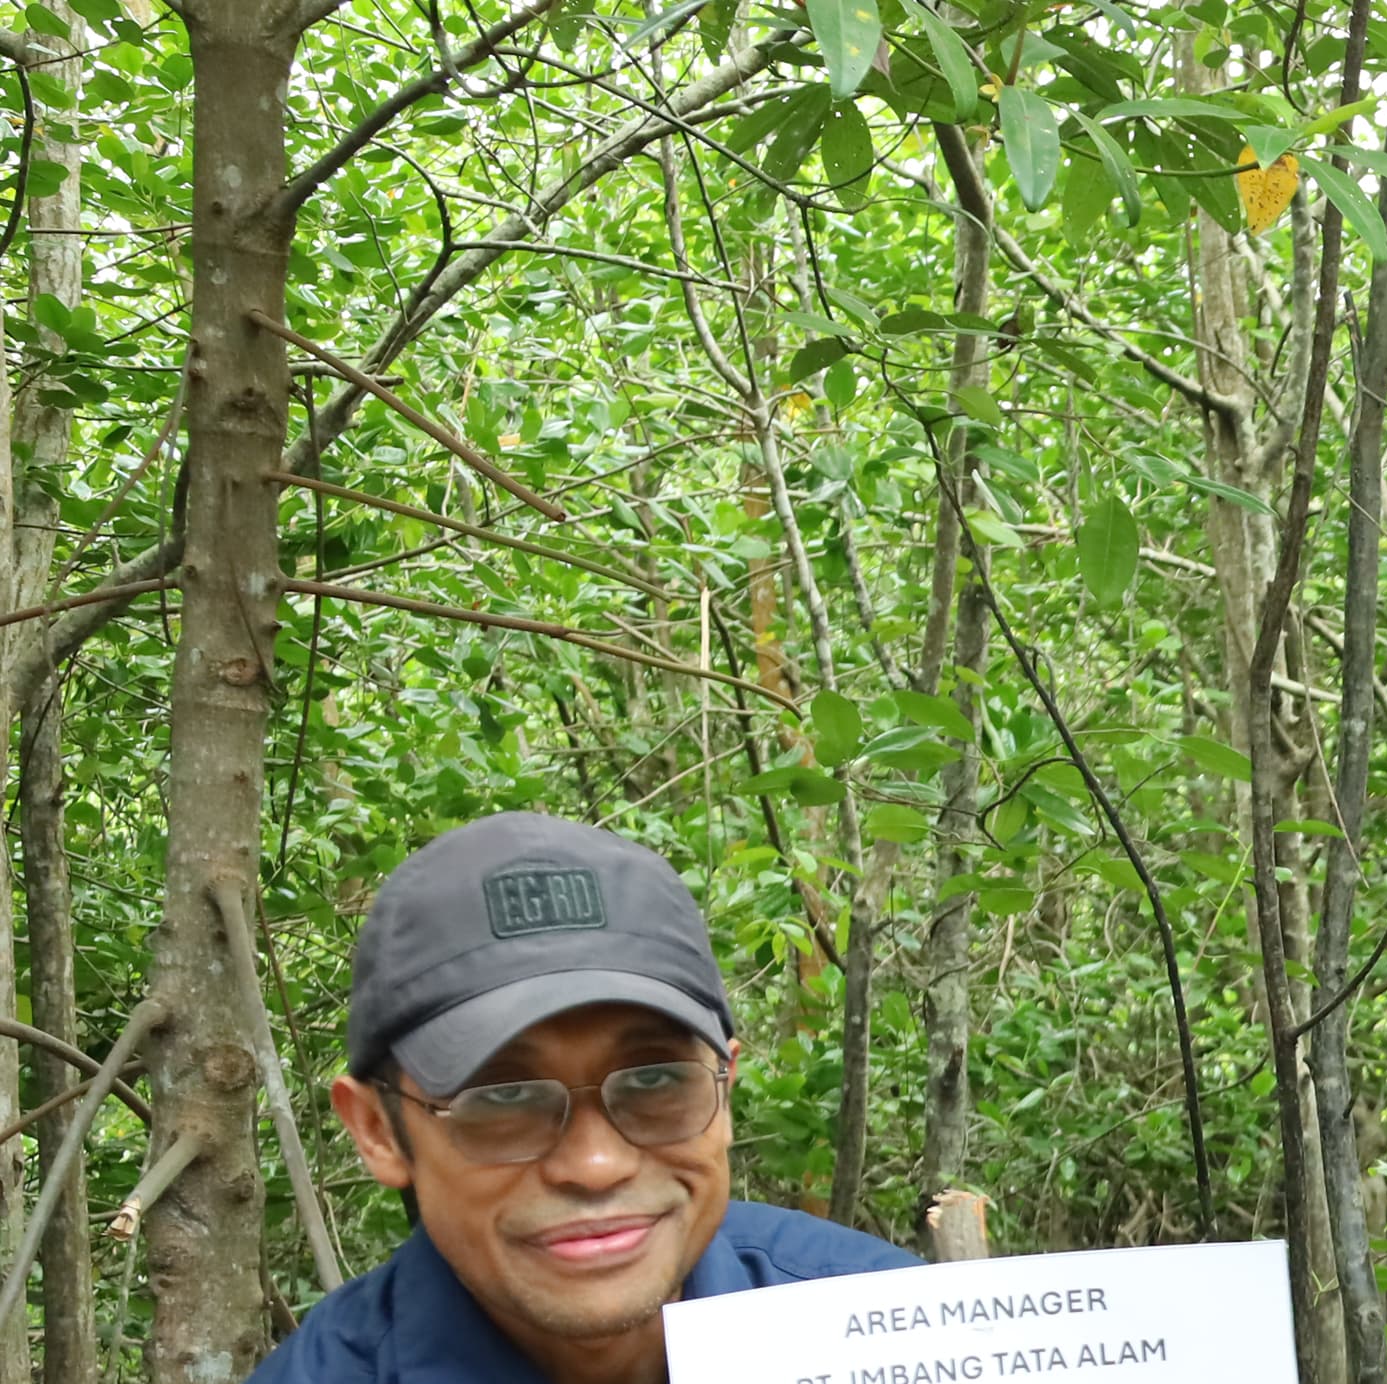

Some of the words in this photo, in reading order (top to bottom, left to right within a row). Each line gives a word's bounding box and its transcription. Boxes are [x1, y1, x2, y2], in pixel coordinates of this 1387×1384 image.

[846, 1305, 931, 1338] AREA
[941, 1287, 1108, 1326] MANAGER
[991, 1347, 1068, 1376] TATA
[1077, 1338, 1168, 1369] ALAM
